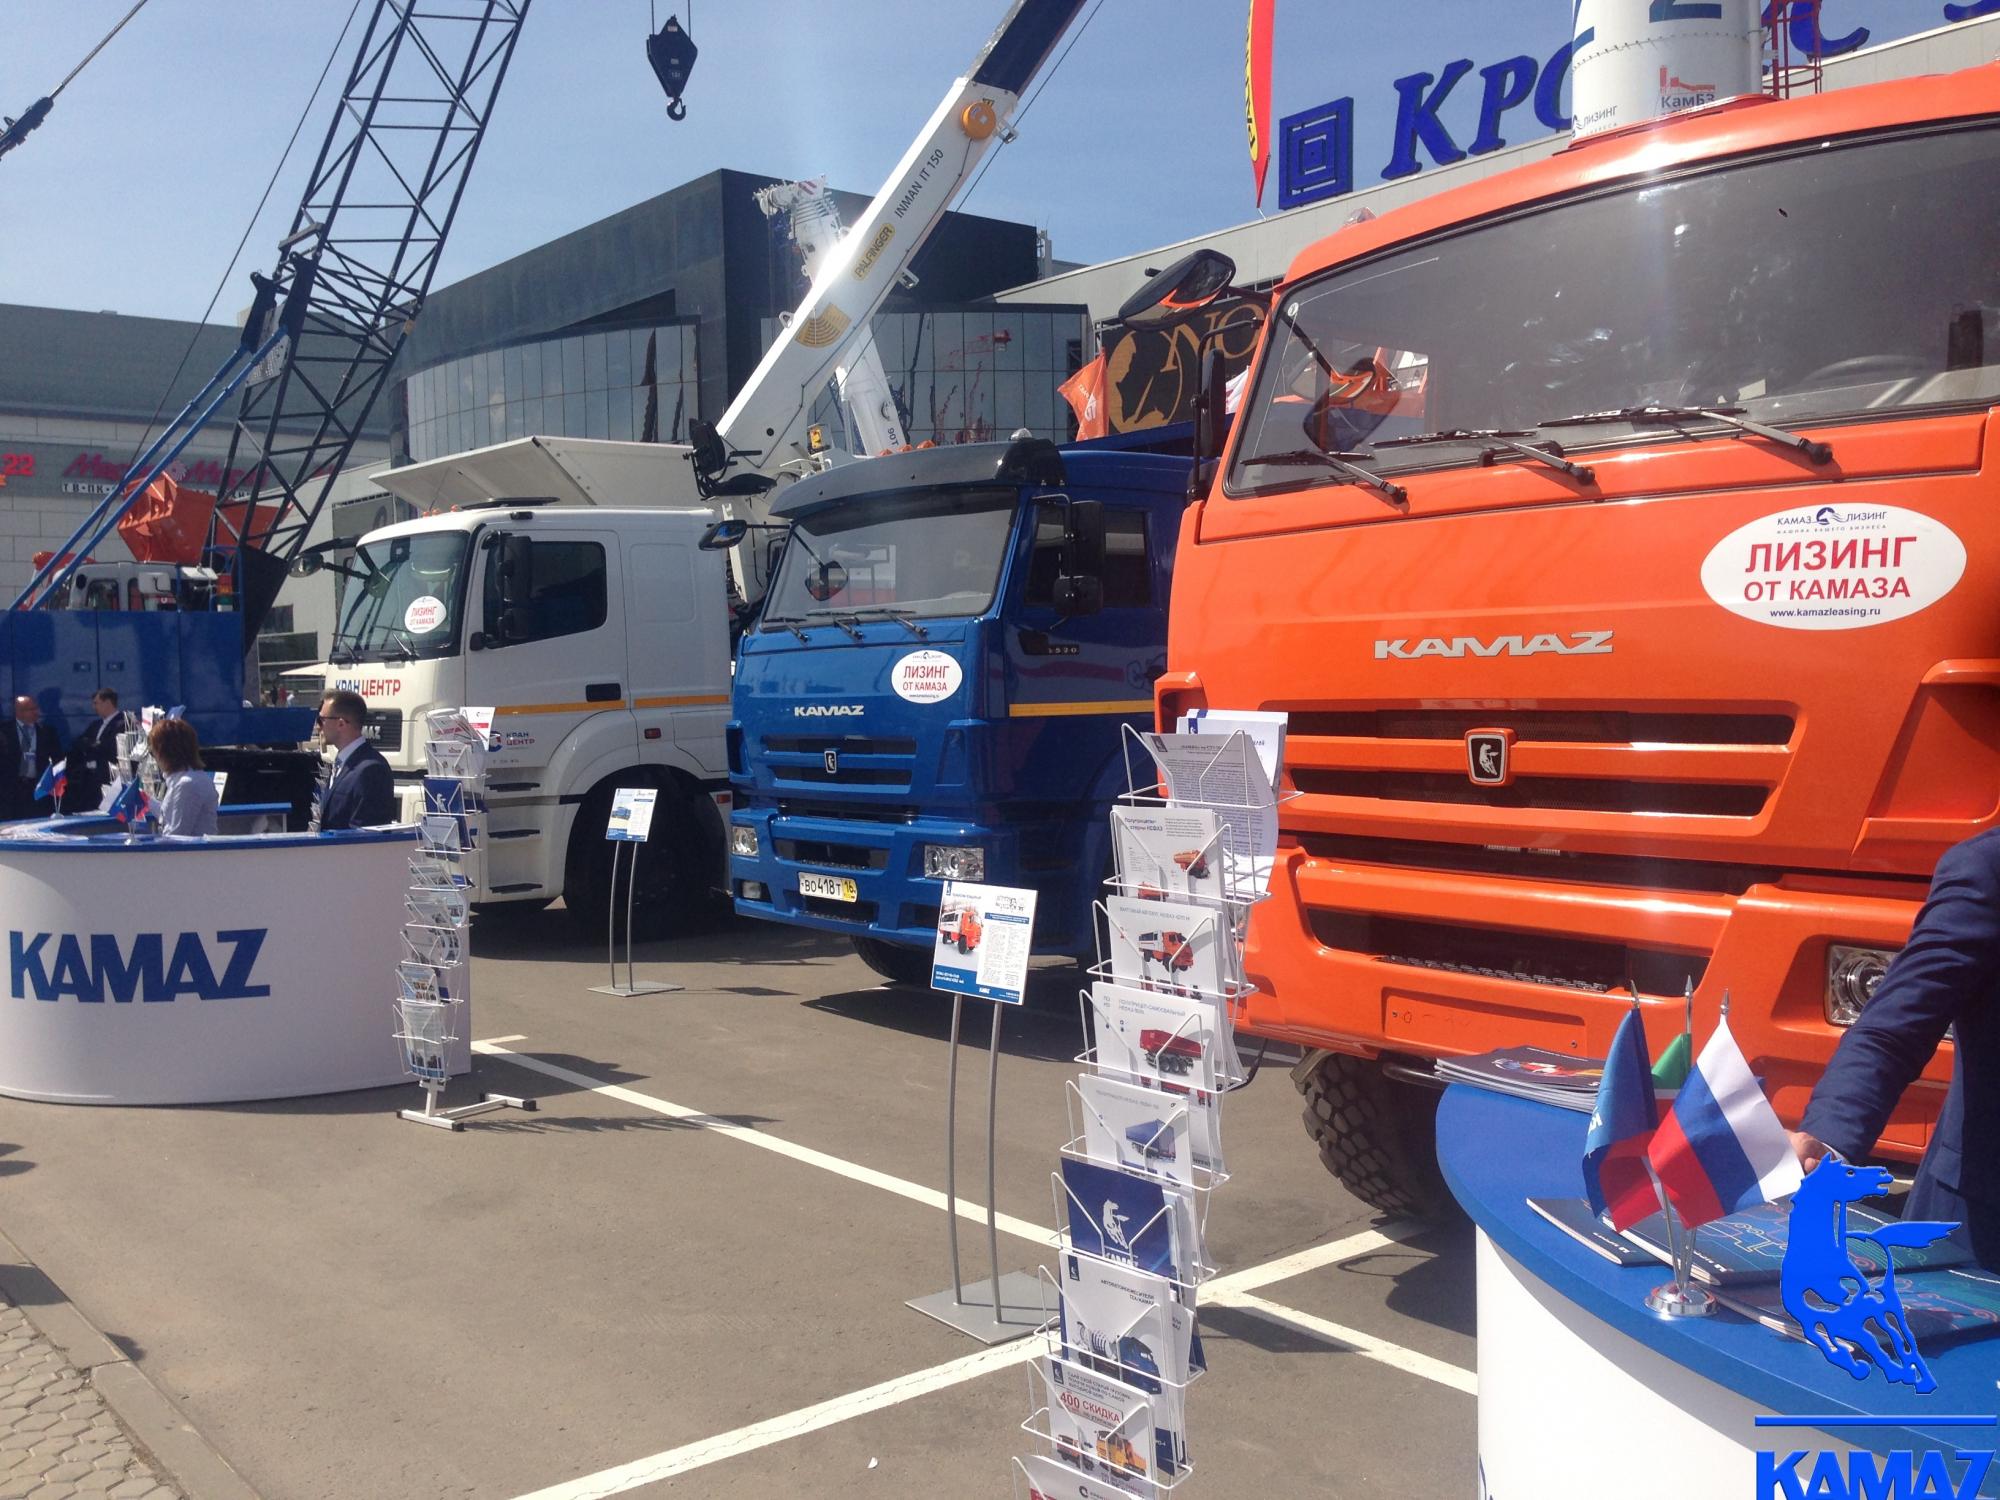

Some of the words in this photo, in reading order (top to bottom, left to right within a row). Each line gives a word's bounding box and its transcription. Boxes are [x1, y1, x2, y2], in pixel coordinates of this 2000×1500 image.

[1584, 105, 1618, 127] ЛИЗИНГ
[894, 181, 922, 218] INMAN
[919, 167, 930, 181] IT
[927, 148, 944, 169] 150
[854, 226, 893, 277] PALFINGER
[1777, 515, 1812, 526] КАМАЗ
[1846, 511, 1888, 523] ЛИЗИНГ
[1745, 536, 1917, 573] ЛИЗИНГ
[1744, 580, 1781, 601] ОТ
[1789, 576, 1911, 601] КАМАЗА
[411, 606, 437, 617] ЛИЗИНГ
[1770, 607, 1881, 618] www.kamazleasing.ru
[1374, 630, 1614, 659] KAMAZ
[903, 665, 950, 679] ЛИЗИНГ
[361, 679, 401, 698] ЦЕНТР
[902, 681, 913, 691] ОТ
[914, 681, 948, 691] КАМАЗА
[794, 705, 865, 718] KAMAZ
[506, 731, 529, 739] КРАН
[506, 738, 535, 746] ЦЕНТР
[9, 928, 271, 1003] KAMAZ
[1060, 1391, 1080, 1409] 400
[1082, 1400, 1121, 1424] СКИДКА
